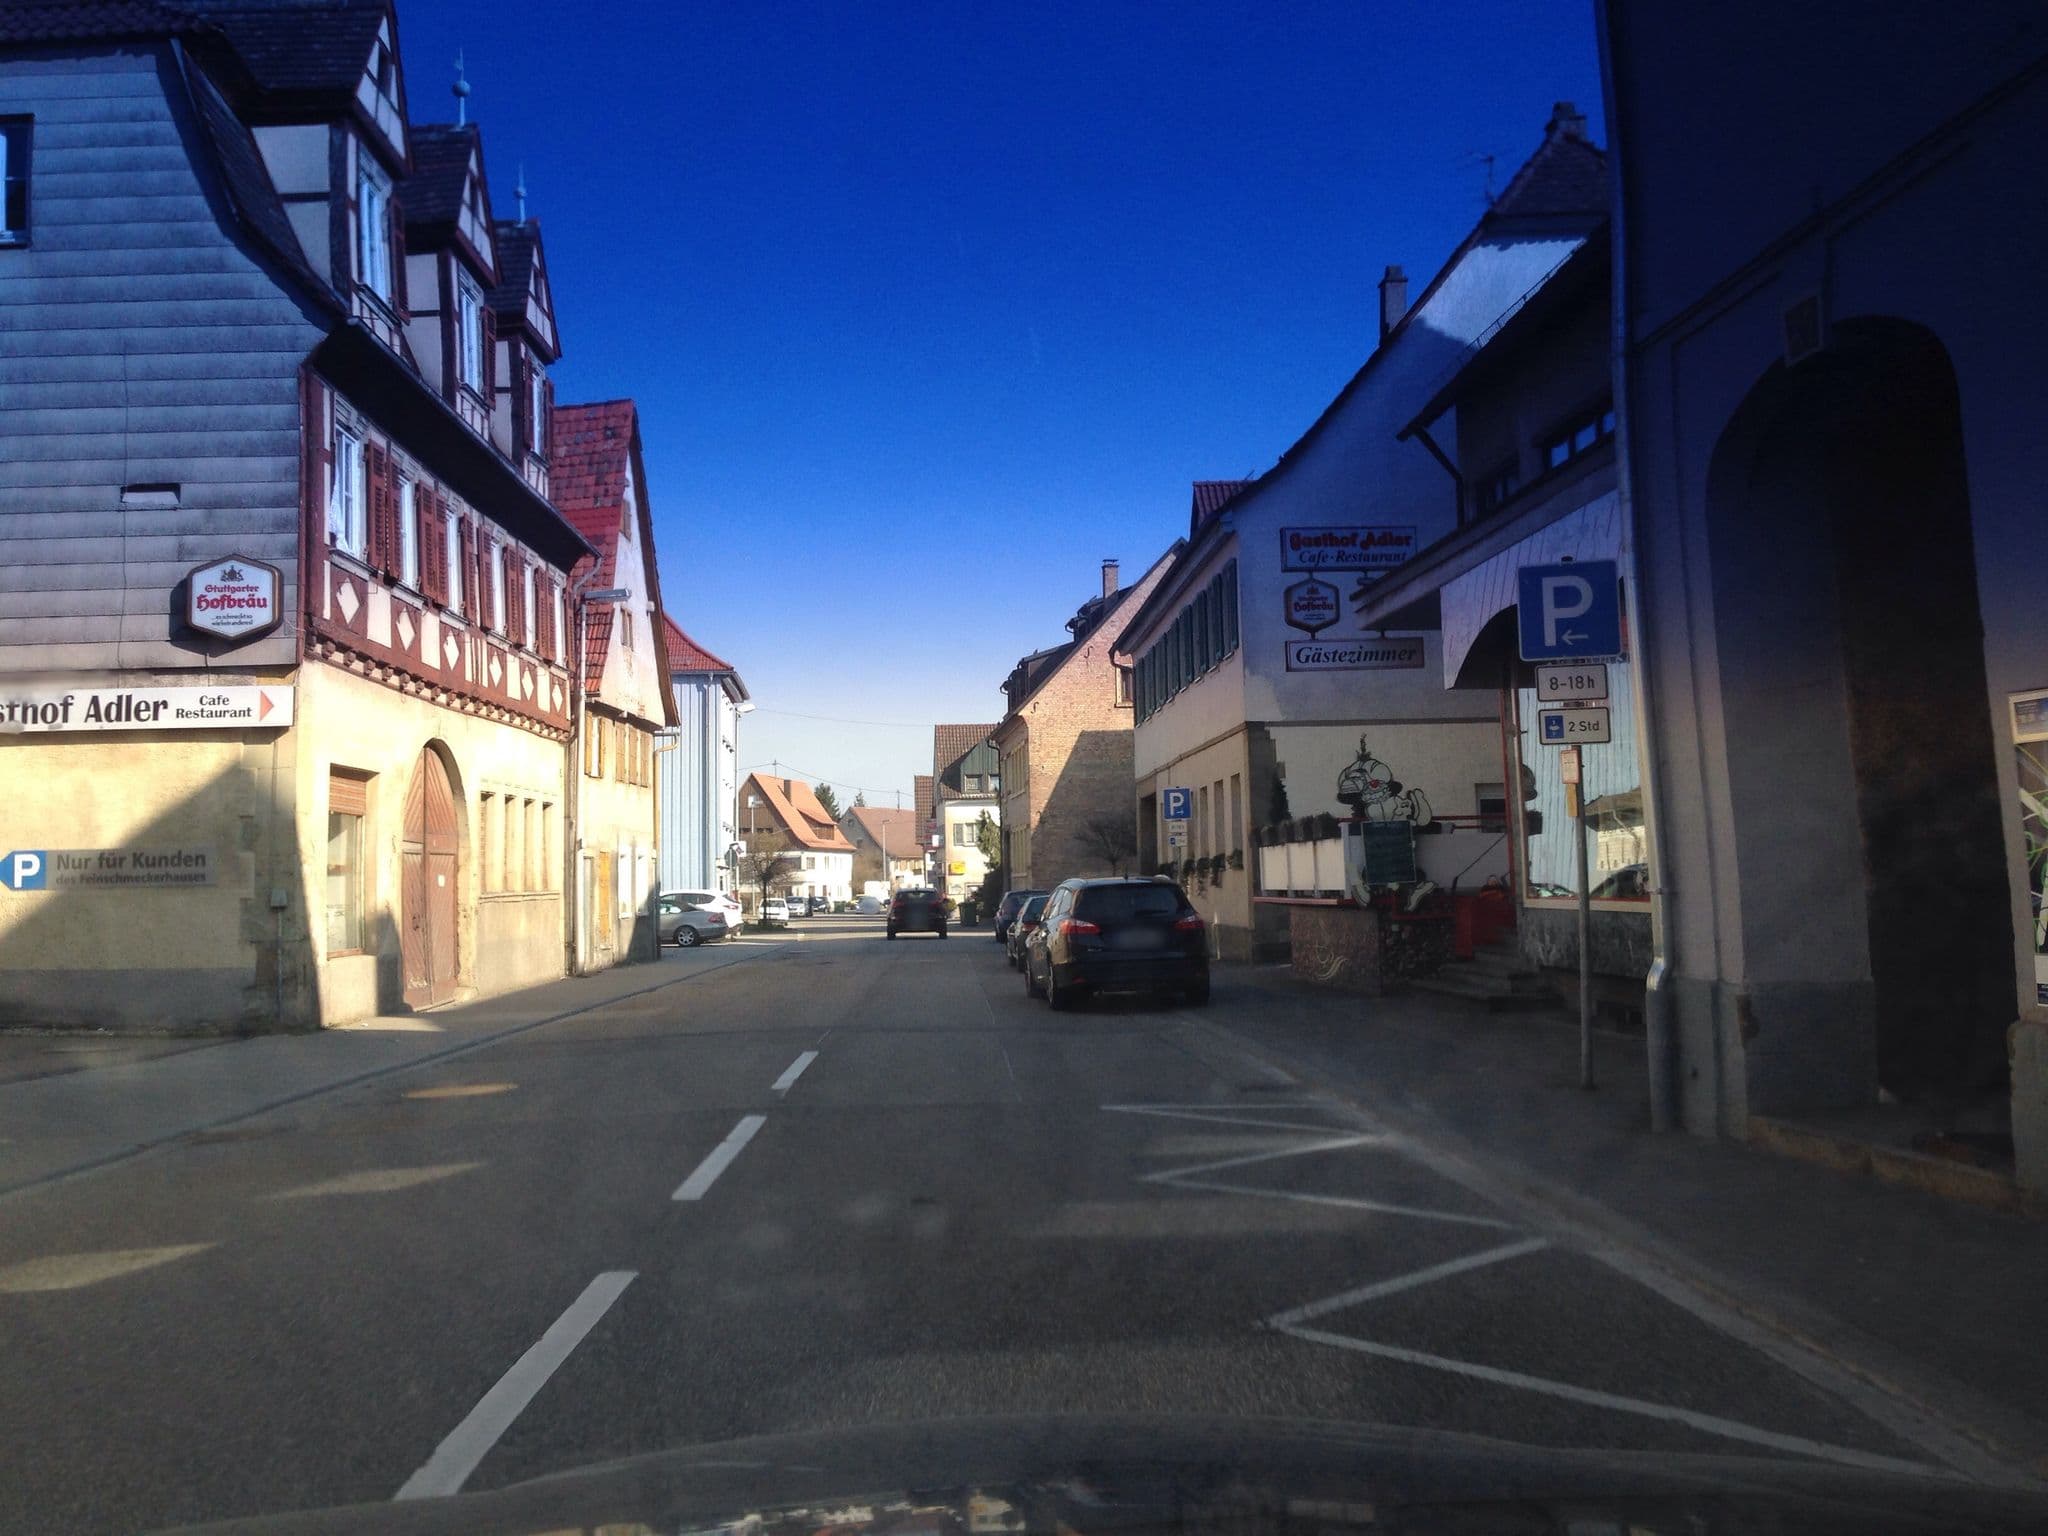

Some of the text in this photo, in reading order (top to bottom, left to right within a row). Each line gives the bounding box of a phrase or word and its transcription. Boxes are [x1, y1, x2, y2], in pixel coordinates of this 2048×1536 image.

[204, 584, 259, 594] Stuttgarter
[196, 594, 267, 611] Hofbräu
[1542, 575, 1593, 647] P
[1296, 646, 1417, 664] Gästezimmer
[199, 694, 229, 706] Cafe
[84, 694, 168, 724] Adler
[175, 706, 252, 719] Restaurant
[1568, 719, 1600, 732] 2 Std
[1170, 792, 1184, 816] P
[13, 850, 206, 889] P Nur für Kunden
